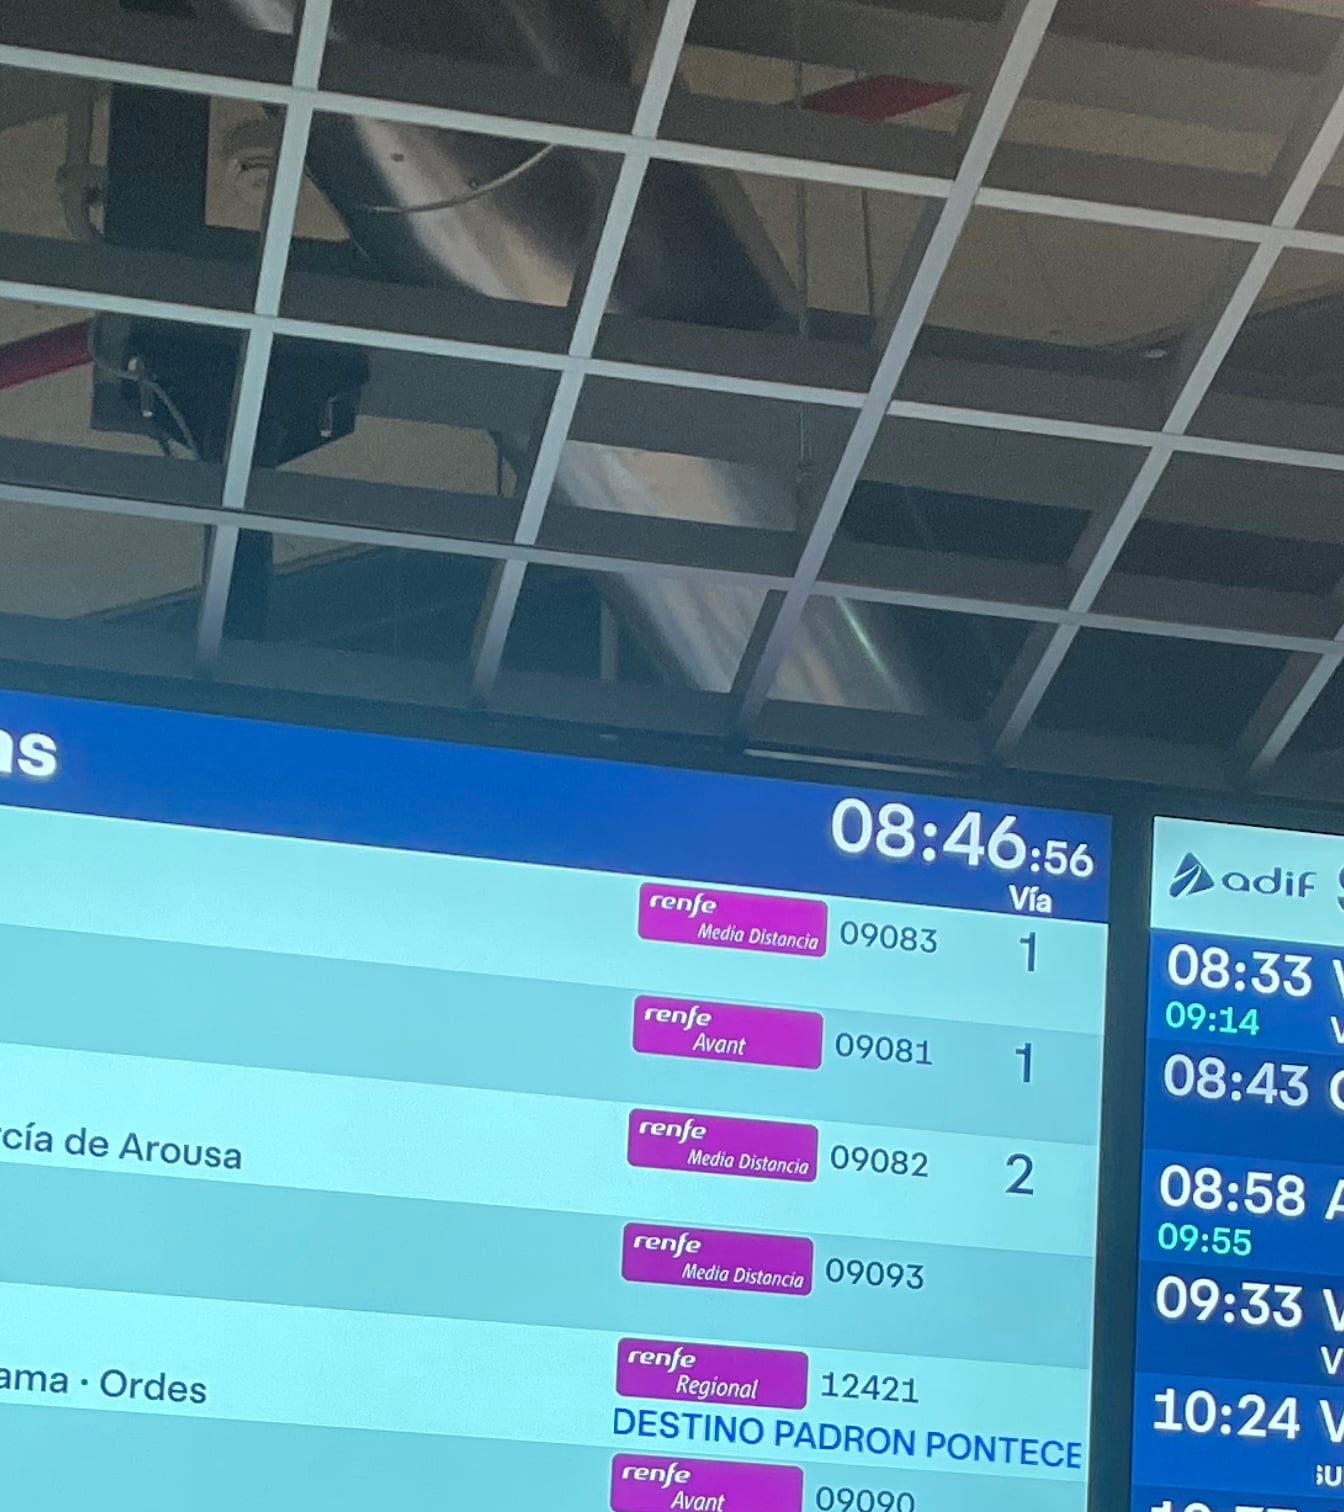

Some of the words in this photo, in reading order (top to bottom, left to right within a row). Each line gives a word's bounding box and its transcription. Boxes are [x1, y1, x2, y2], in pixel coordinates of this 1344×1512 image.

[1008, 884, 1052, 914] Vía
[1221, 867, 1316, 898] adif
[697, 922, 745, 943] Media
[748, 927, 819, 951] Distancia
[840, 920, 937, 954] 09083
[1019, 932, 1036, 972] 1
[1168, 943, 1312, 997] 08:33
[1165, 1000, 1260, 1036] 09:14
[692, 1032, 747, 1056] Avant
[835, 1032, 933, 1066] 09081
[1015, 1042, 1032, 1083] 1
[1164, 1053, 1309, 1107] 08:43
[64, 1127, 109, 1158] de
[118, 1132, 242, 1170] Arousa
[687, 1148, 735, 1168] Media
[738, 1153, 810, 1175] Distancia
[830, 1144, 928, 1178] 09082
[1005, 1153, 1034, 1196] 2
[1160, 1164, 1305, 1217] 08:58
[1157, 1222, 1252, 1257] 09:55
[681, 1262, 730, 1282] Media
[732, 1266, 805, 1289] Distancia
[825, 1257, 924, 1290] 09093
[1156, 1275, 1303, 1328] 09:33
[99, 1368, 207, 1404] Ordes
[675, 1374, 759, 1401] Regional
[821, 1371, 919, 1404] 12421
[1153, 1388, 1301, 1440] 10:24
[613, 1407, 765, 1445] DESTINO
[774, 1419, 916, 1457] PADRON
[926, 1431, 1082, 1469] PONTECE
[670, 1490, 726, 1512] Avant
